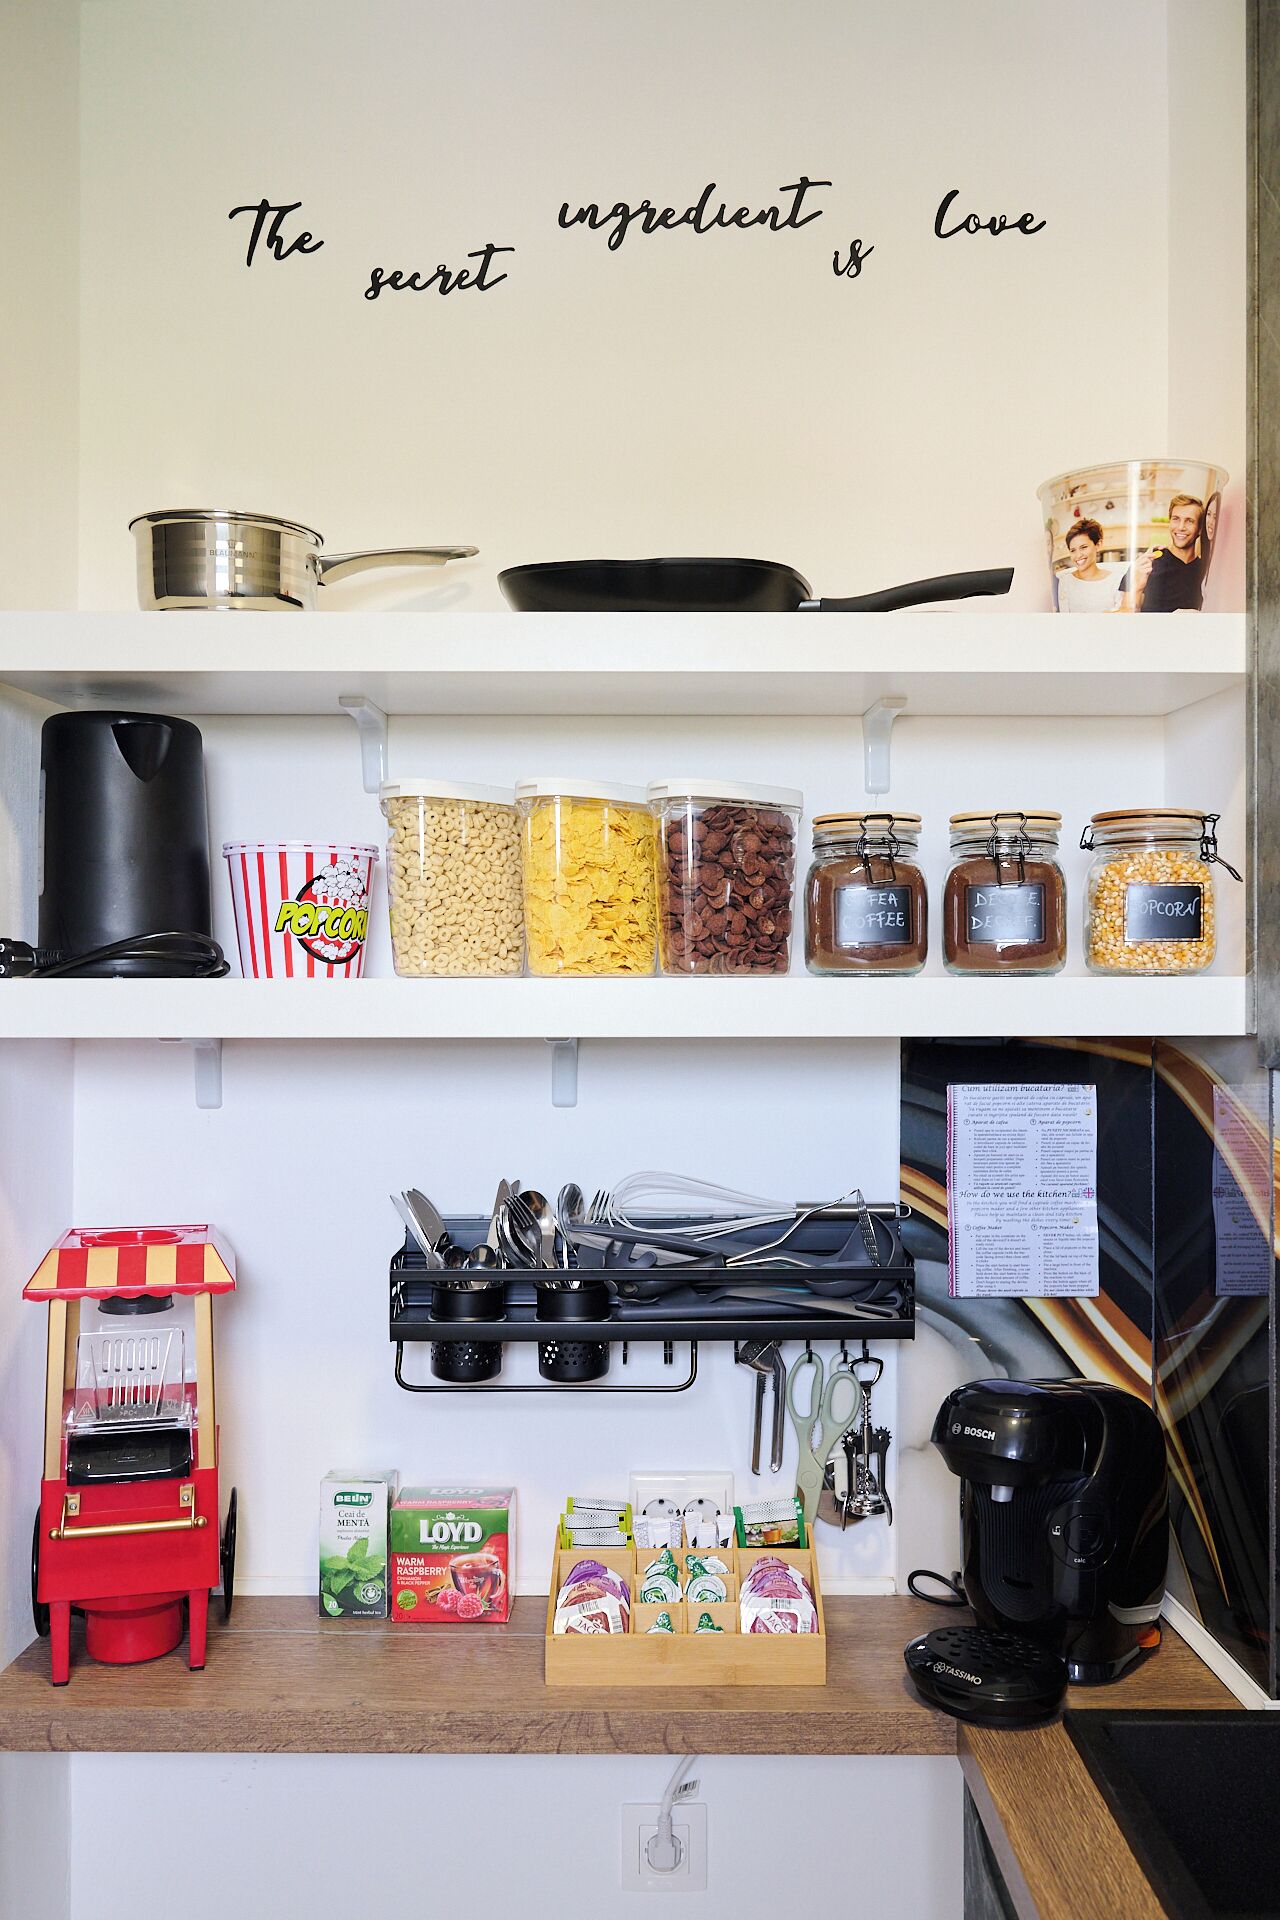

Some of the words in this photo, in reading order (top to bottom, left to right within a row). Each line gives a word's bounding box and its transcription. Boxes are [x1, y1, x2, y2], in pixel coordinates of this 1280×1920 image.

[229, 199, 325, 268] The
[364, 243, 516, 301] secret
[557, 176, 833, 252] ingredient
[832, 238, 875, 279] is
[845, 893, 899, 907] FEA
[1132, 896, 1200, 917] OPCORN
[842, 910, 905, 929] COFFEE
[959, 1190, 978, 1198] How
[980, 1190, 991, 1198] do
[993, 1190, 1004, 1198] we
[1006, 1190, 1020, 1198] use
[1022, 1190, 1034, 1198] the
[1037, 1190, 1072, 1198] kitchen?
[964, 1426, 996, 1440] BOSCH
[338, 1510, 355, 1518] Ceai
[356, 1510, 366, 1518] de
[419, 1519, 483, 1544] LOYD
[396, 1557, 425, 1566] WARM
[396, 1567, 447, 1576] RASPBERRY
[945, 1665, 982, 1685] TASSIMO
